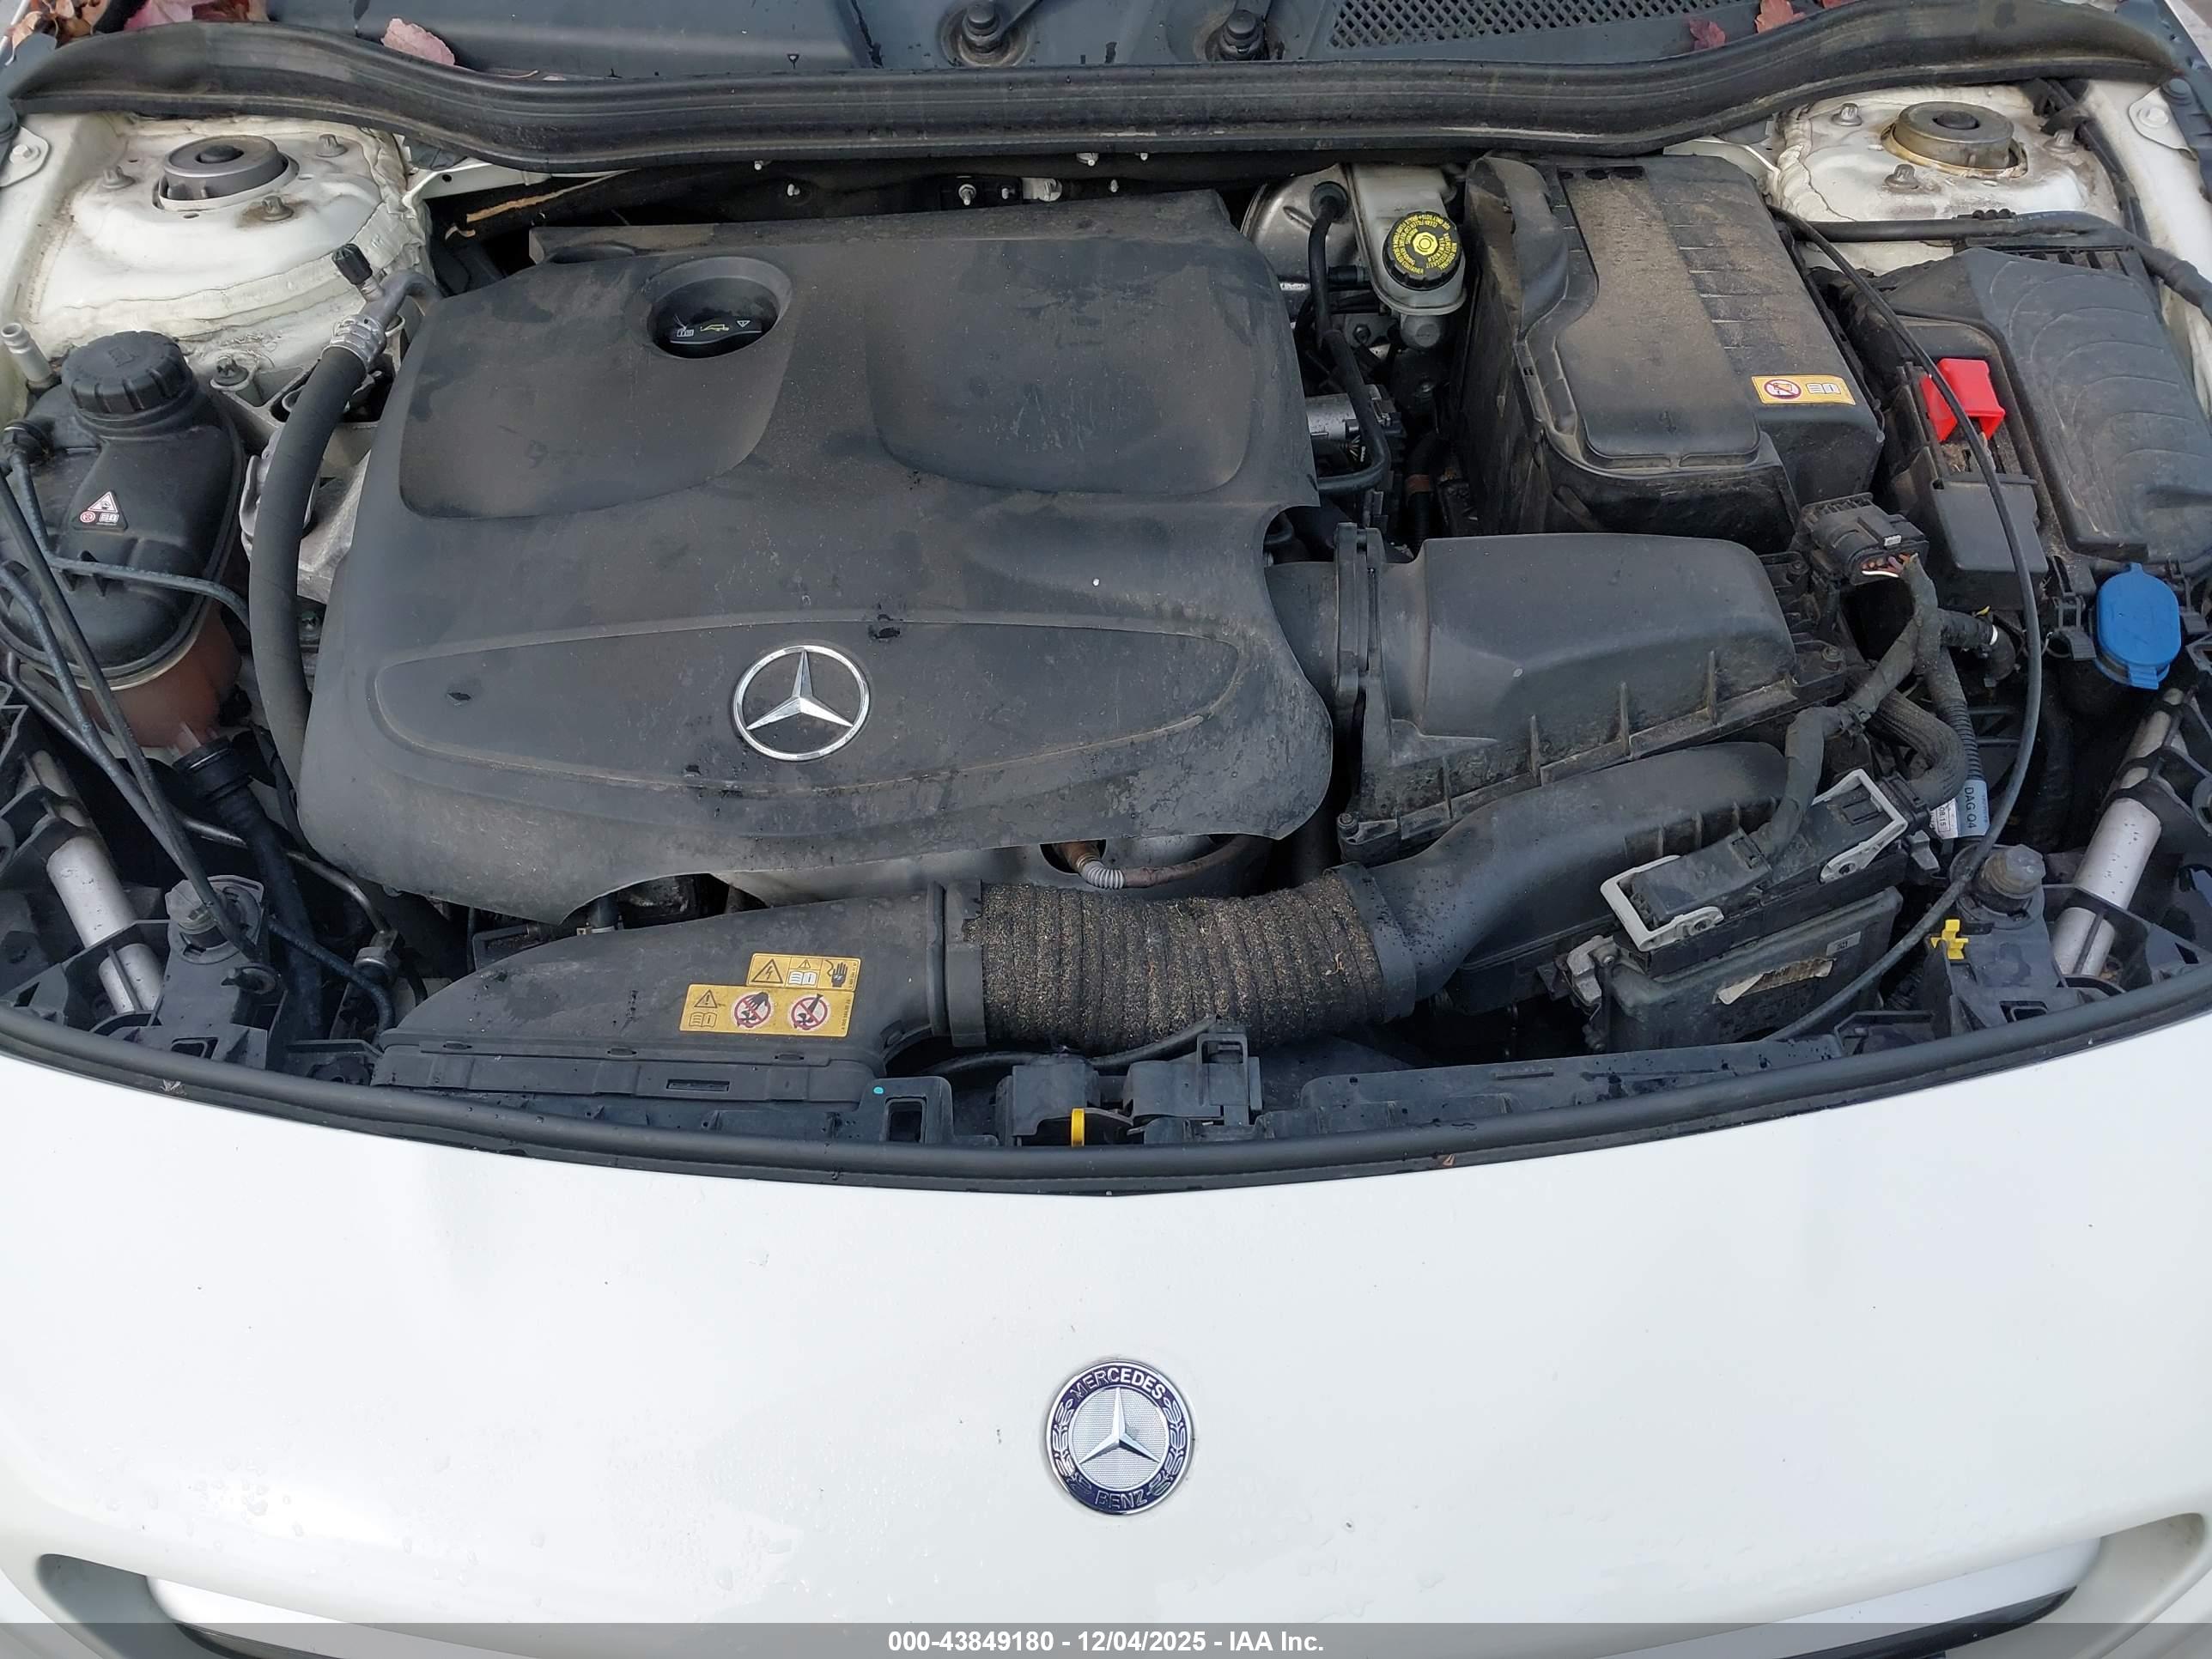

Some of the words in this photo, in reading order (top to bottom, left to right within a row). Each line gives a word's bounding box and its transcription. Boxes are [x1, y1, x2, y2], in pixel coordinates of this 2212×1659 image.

[1965, 787, 1976, 810] DAG
[1966, 813, 1977, 829] Q4
[1070, 1367, 1165, 1400] MERCEDES
[1095, 1488, 1147, 1509] BENZ
